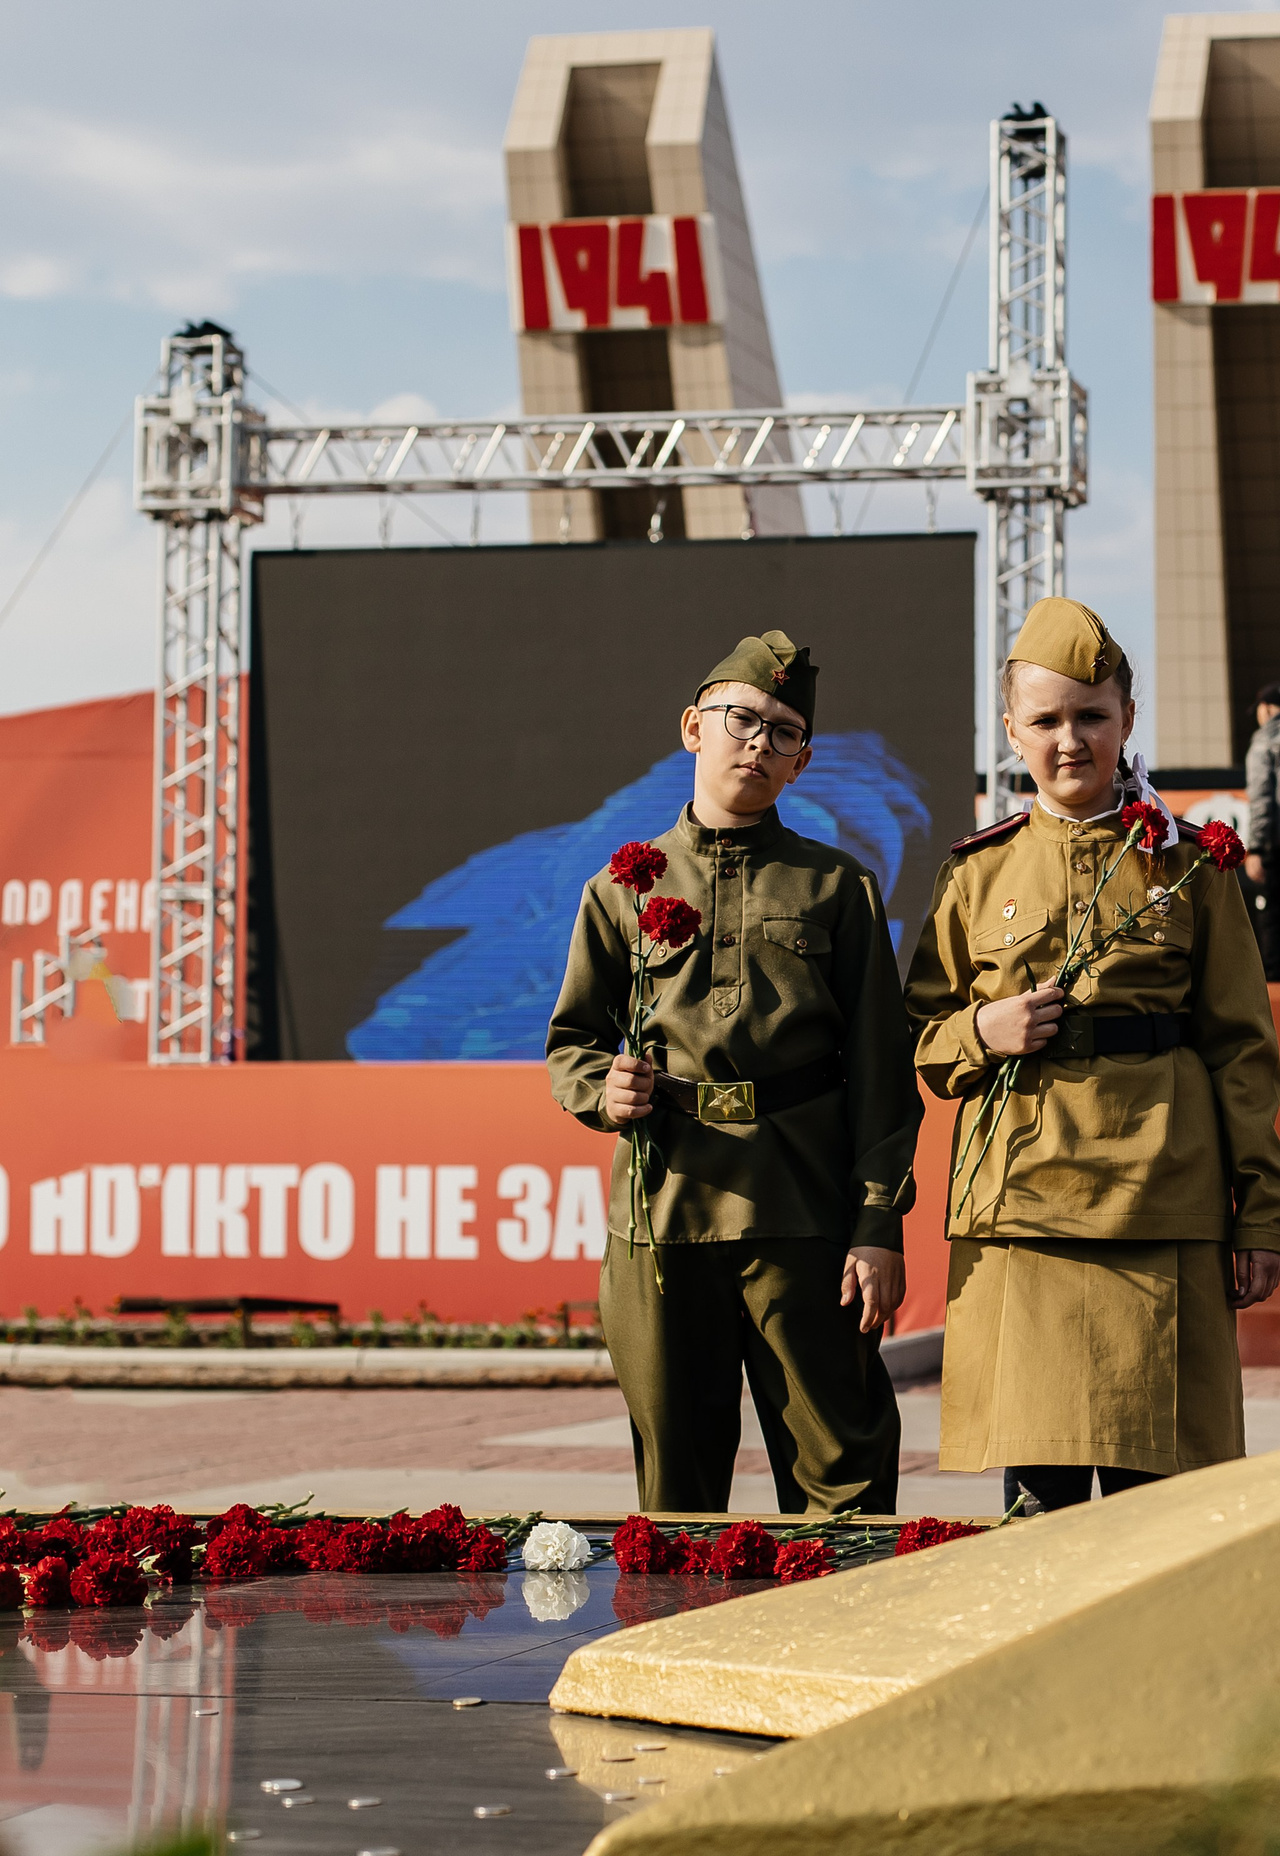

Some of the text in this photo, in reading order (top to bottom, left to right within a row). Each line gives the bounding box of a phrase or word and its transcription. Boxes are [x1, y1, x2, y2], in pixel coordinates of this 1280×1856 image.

[517, 214, 711, 331] 1941
[375, 1164, 479, 1260] НЕ
[497, 1163, 606, 1262] ЗА
